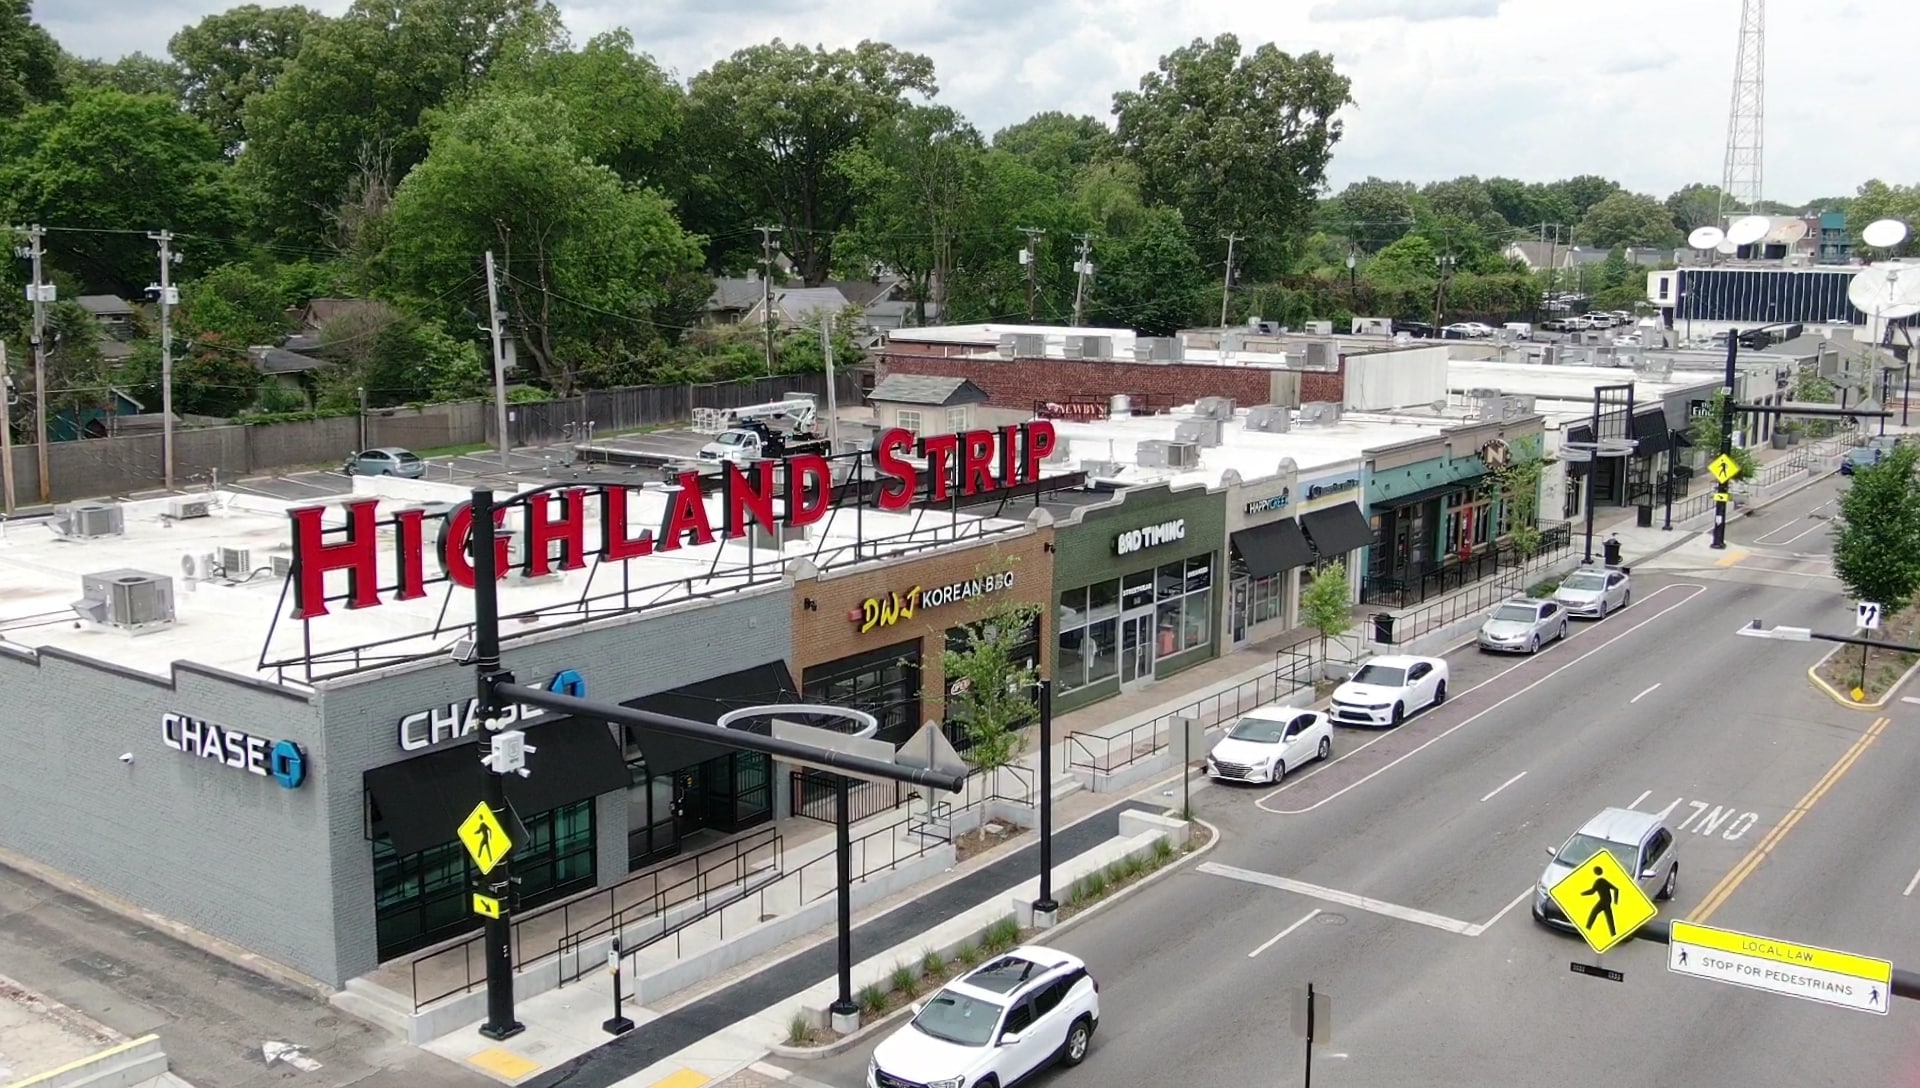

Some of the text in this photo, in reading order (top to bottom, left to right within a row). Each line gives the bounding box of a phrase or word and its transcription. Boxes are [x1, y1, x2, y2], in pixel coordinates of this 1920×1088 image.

[288, 420, 1056, 620] HIGHLAND STRIP
[1117, 518, 1185, 555] BAD TIMING
[861, 570, 1015, 634] DWJ KOREAN BBQ
[162, 712, 268, 777] CHASE
[1702, 956, 1854, 996] STOP FOR PEDESTRIANS
[1741, 940, 1815, 963] LOCAL LAW
